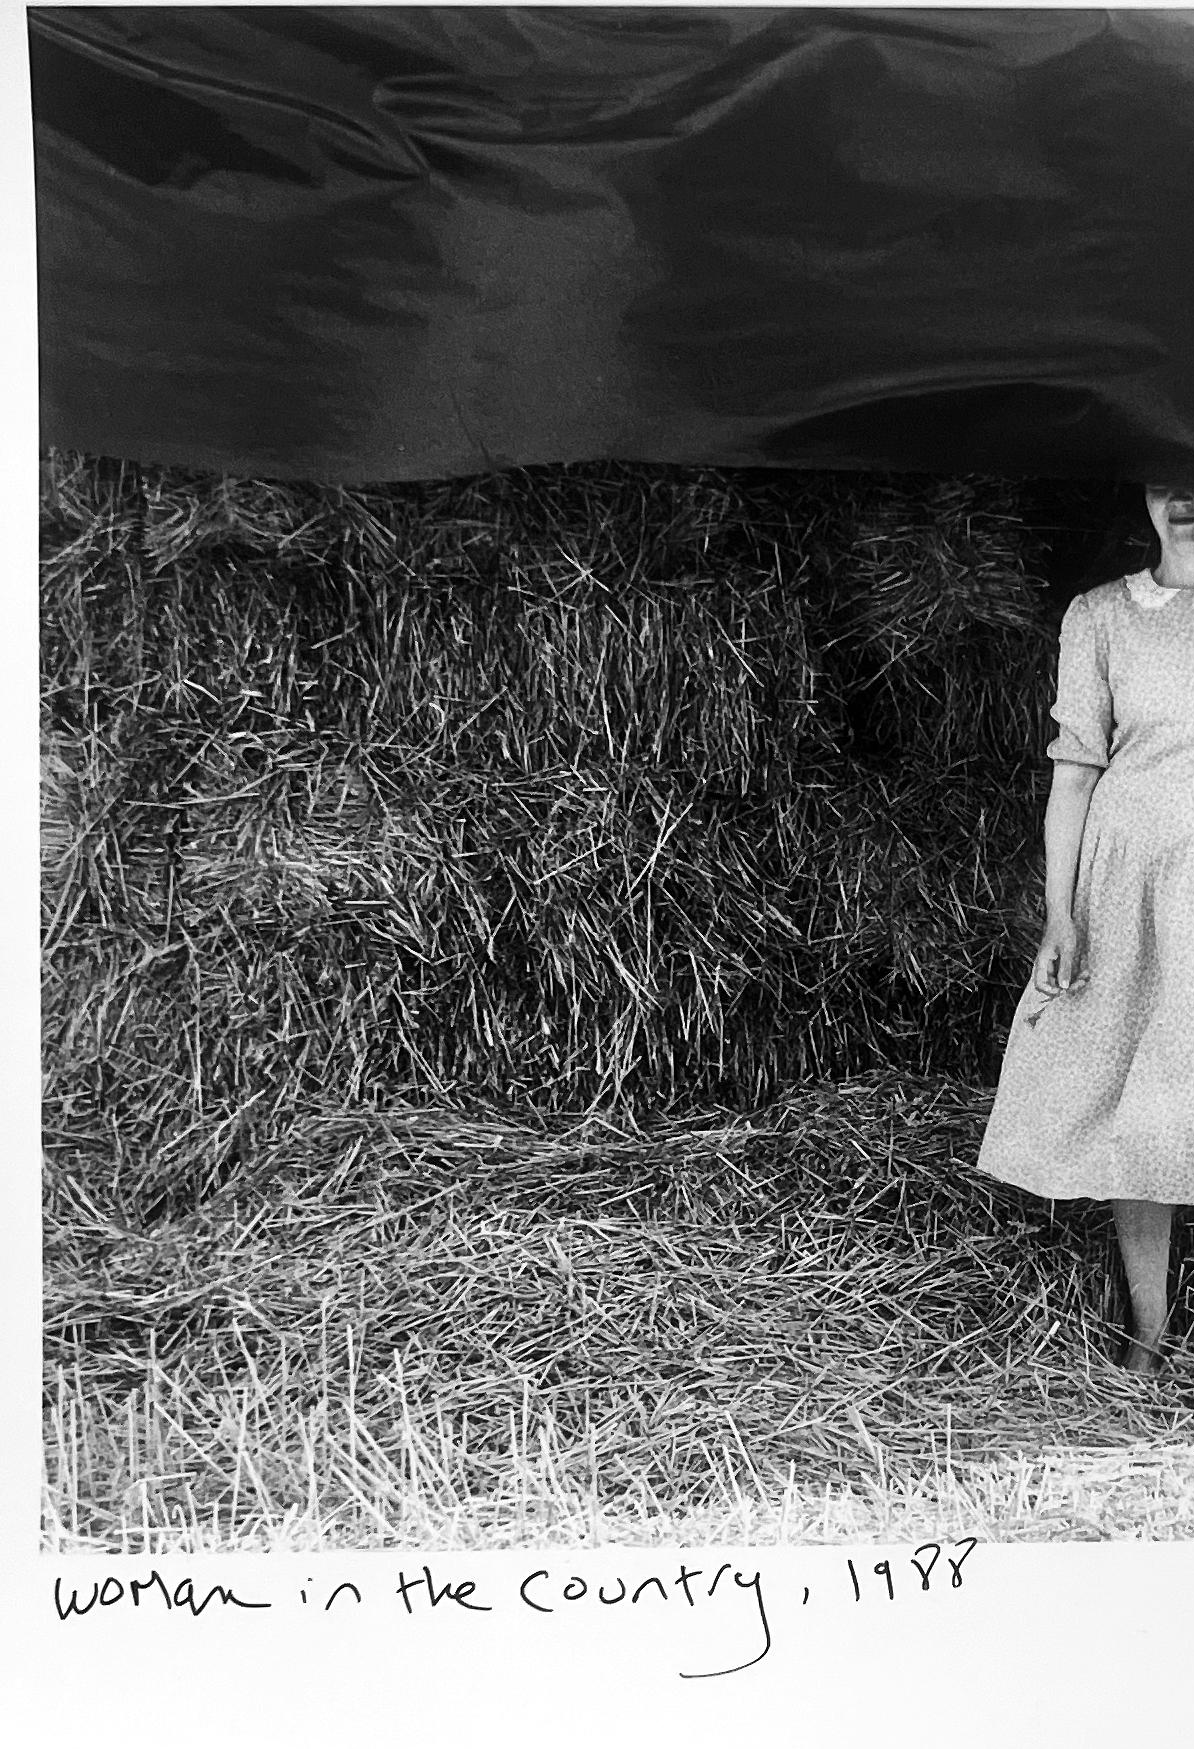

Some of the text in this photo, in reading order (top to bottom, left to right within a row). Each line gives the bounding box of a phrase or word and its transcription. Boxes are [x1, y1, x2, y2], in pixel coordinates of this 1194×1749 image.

[300, 1577, 362, 1611] in
[395, 1565, 493, 1614] the
[847, 1537, 978, 1603] 1988
